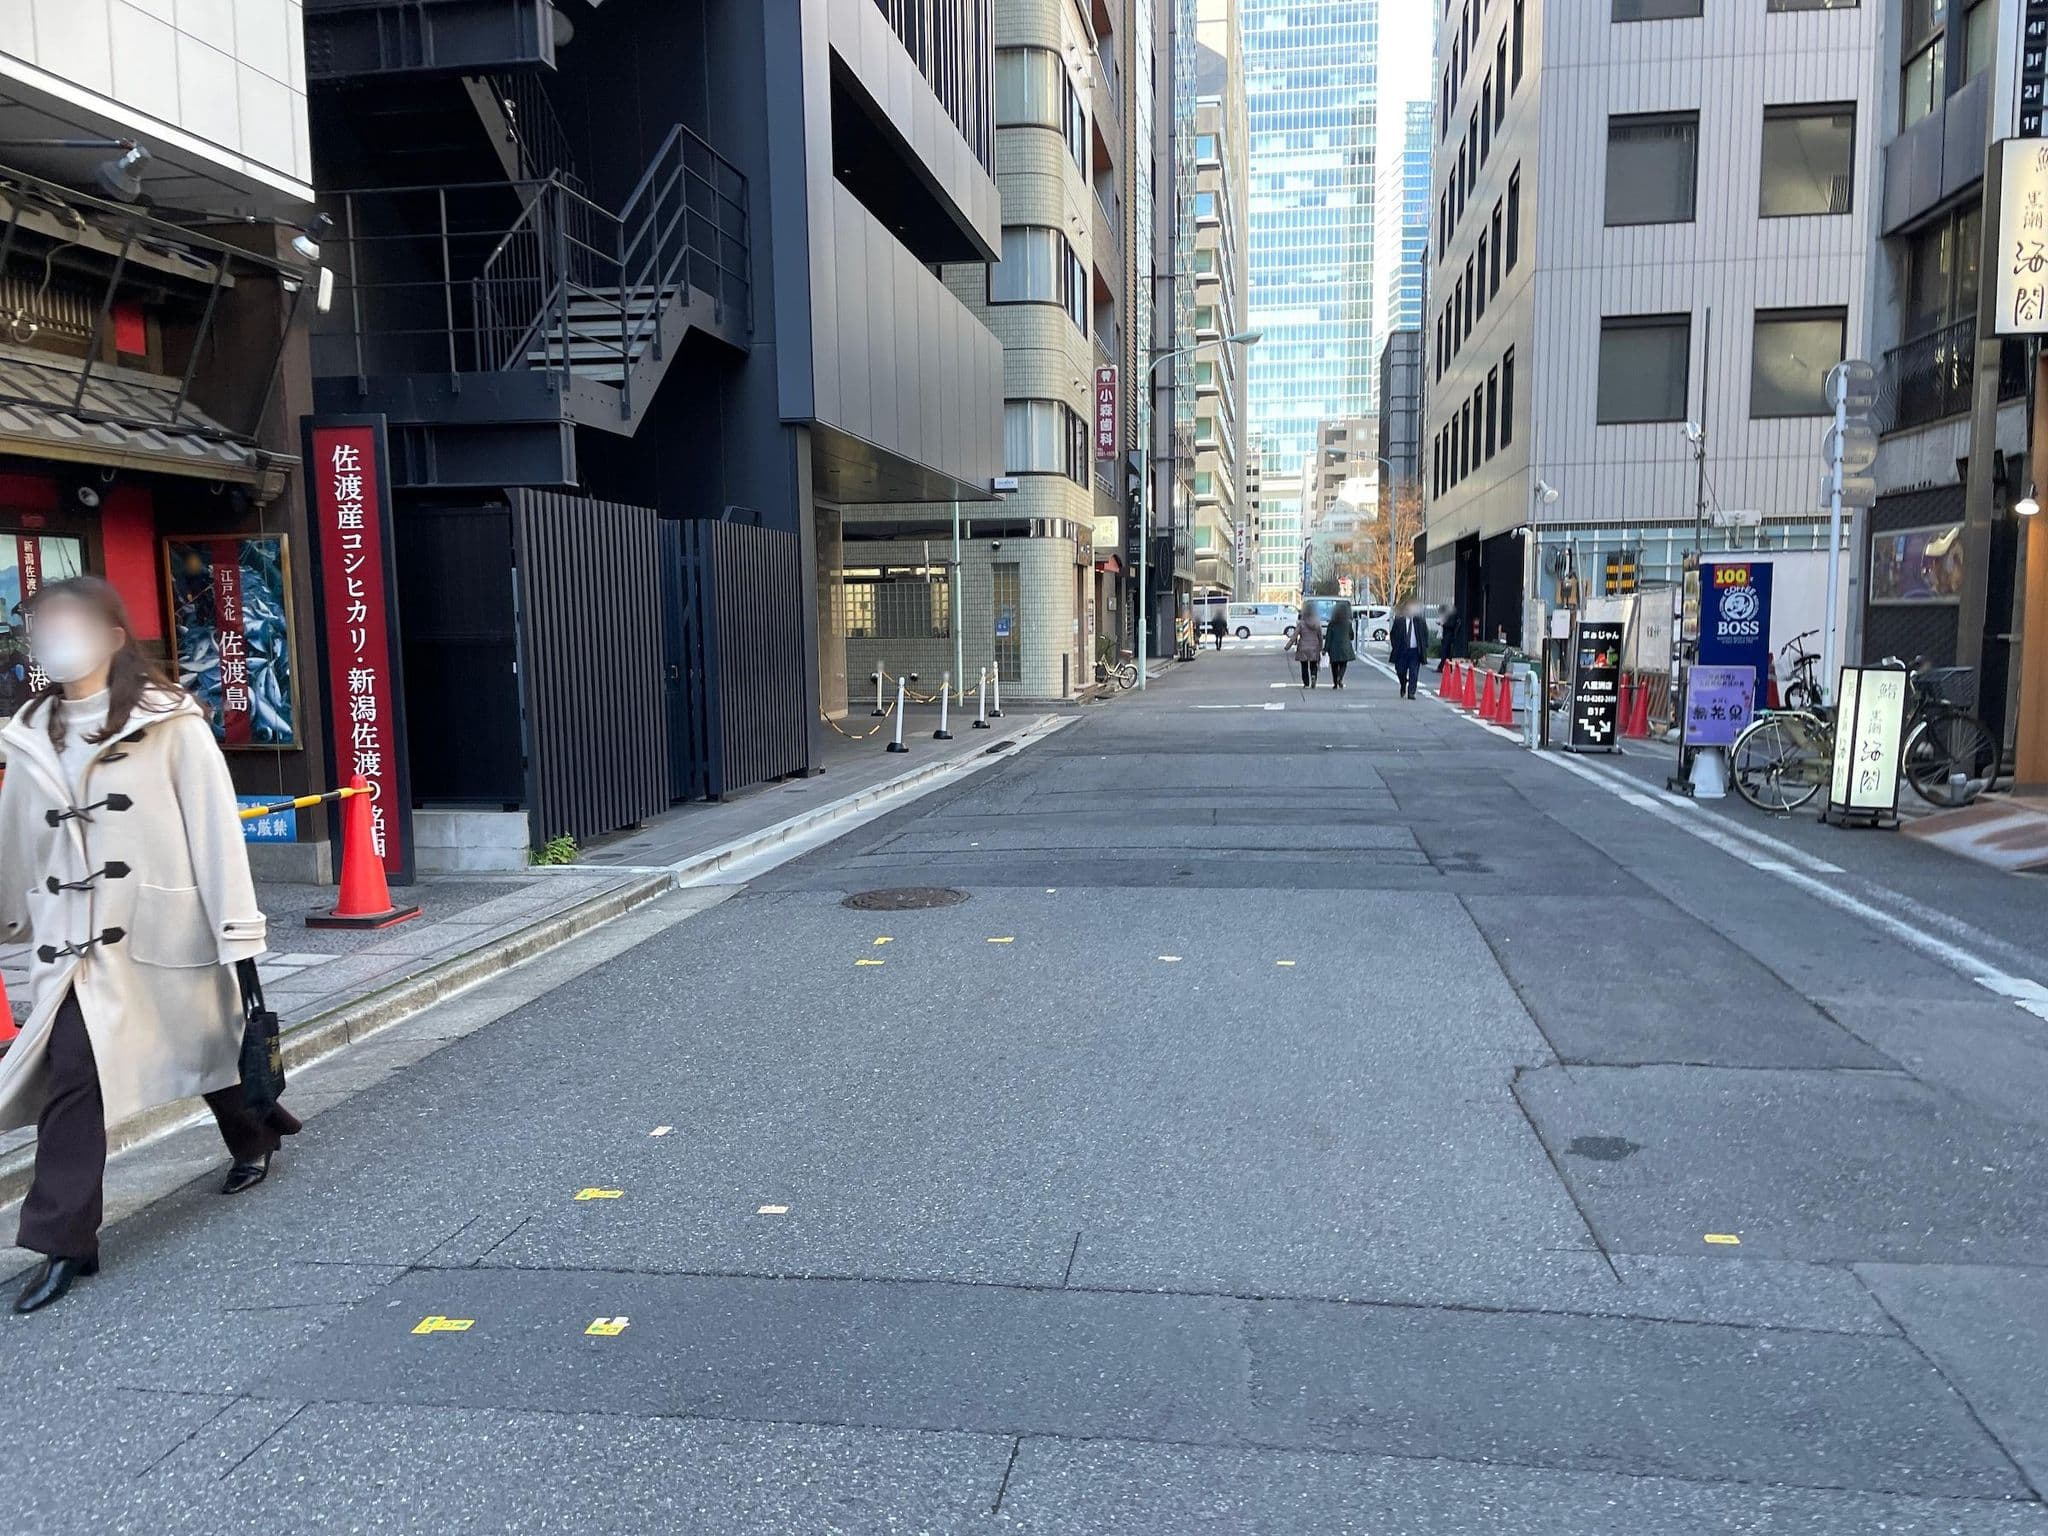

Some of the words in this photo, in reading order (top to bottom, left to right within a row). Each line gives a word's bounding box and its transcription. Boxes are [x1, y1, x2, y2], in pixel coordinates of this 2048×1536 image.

[2028, 21, 2046, 35] 4F
[2024, 84, 2041, 99] 2F
[2023, 116, 2039, 130] 1F
[1100, 388, 1113, 446] 小森歯科
[1715, 569, 1747, 584] 100
[221, 569, 236, 621] 江戸文化
[1717, 621, 1759, 636] BOSS
[219, 631, 248, 711] 佐渡島
[1587, 707, 1605, 716] B1F
